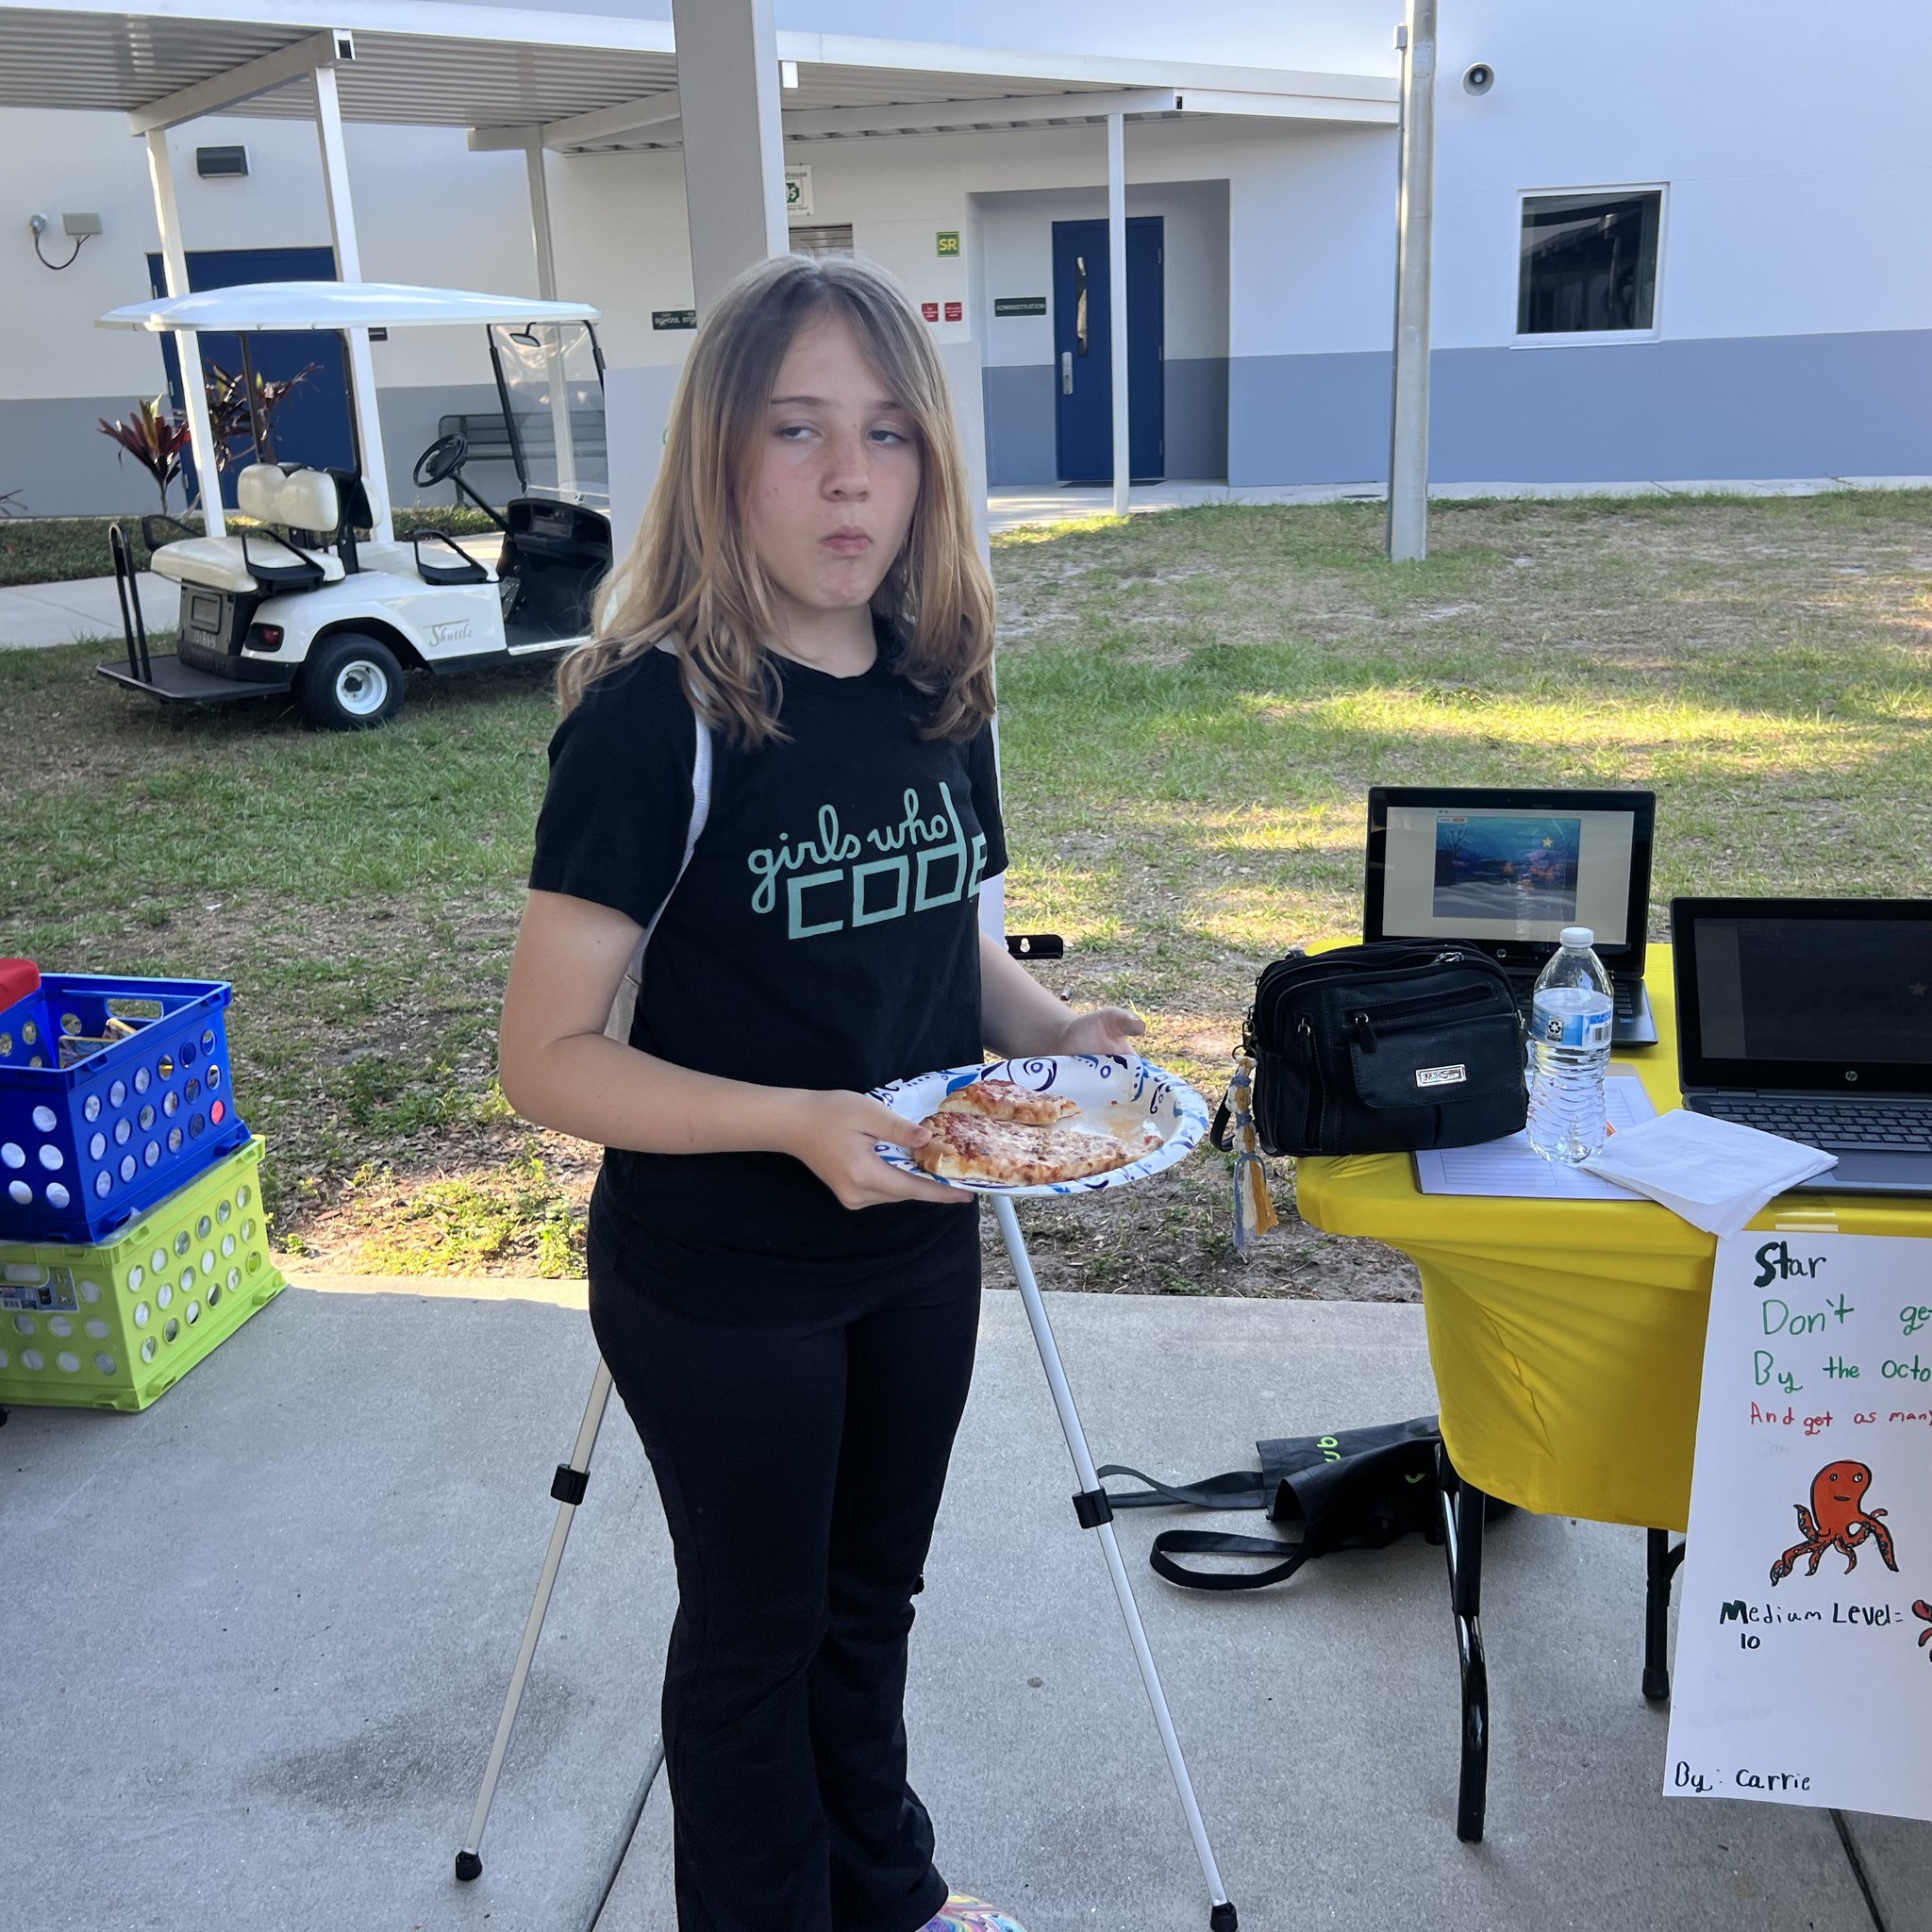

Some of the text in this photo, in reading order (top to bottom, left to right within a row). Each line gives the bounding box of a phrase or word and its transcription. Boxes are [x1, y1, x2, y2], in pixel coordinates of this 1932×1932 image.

[939, 238, 958, 252] SR
[424, 619, 473, 647] Shuttle
[748, 787, 948, 914] girls who
[1753, 1240, 1827, 1289] Star
[1762, 1293, 1932, 1337] Don't ge
[1754, 1350, 1804, 1394] By
[1822, 1355, 1860, 1380] the
[1750, 1401, 1795, 1425] And
[1803, 1409, 1834, 1437] get
[1853, 1411, 1877, 1424] as
[1719, 1599, 1823, 1625] Medium
[1740, 1633, 1761, 1650] 10
